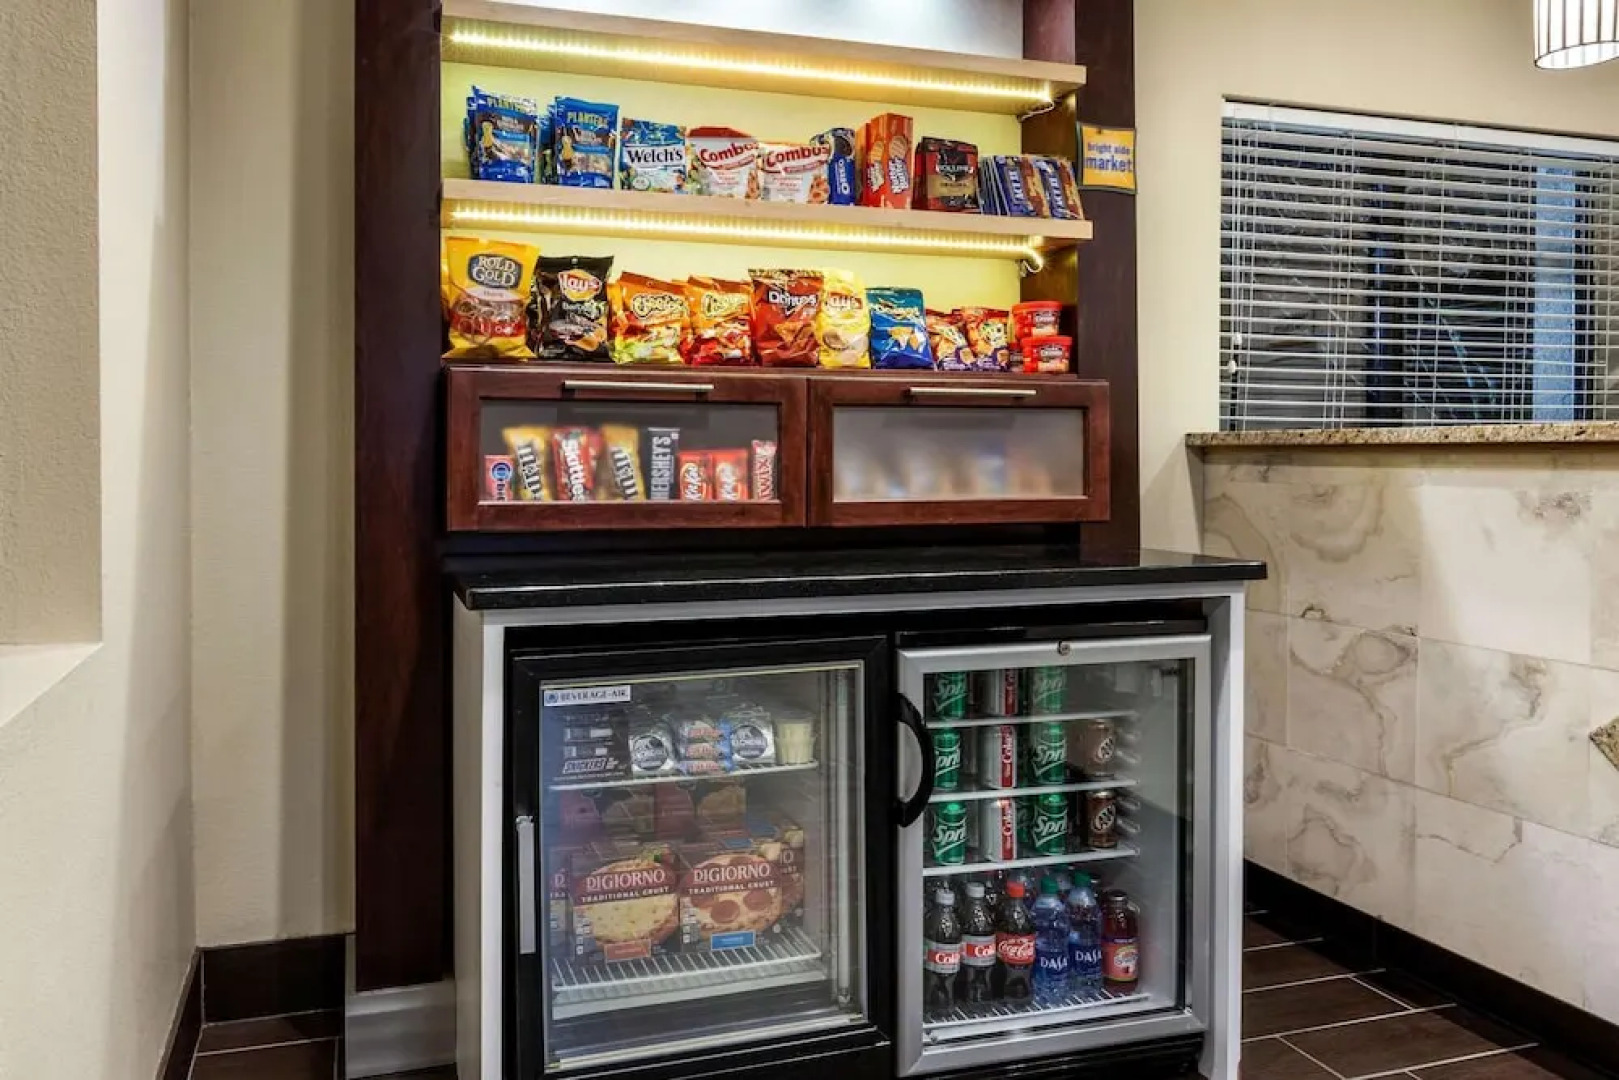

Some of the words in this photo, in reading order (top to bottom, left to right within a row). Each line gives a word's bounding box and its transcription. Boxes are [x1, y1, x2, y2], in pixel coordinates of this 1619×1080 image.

[627, 148, 683, 163] Welch's
[766, 145, 830, 167] Combos
[1083, 155, 1132, 172] market
[479, 256, 516, 271] ROLD
[472, 266, 517, 286] GOLD
[561, 437, 586, 501] Skittles
[650, 437, 671, 500] HERSHEY'S
[586, 869, 664, 893] DIGIORNO
[693, 862, 769, 885] DIGIORNO
[582, 890, 640, 903] TRADITIONAL
[642, 886, 669, 896] CRUST
[688, 883, 745, 895] TRADITIONAL
[747, 880, 774, 889] CRUST
